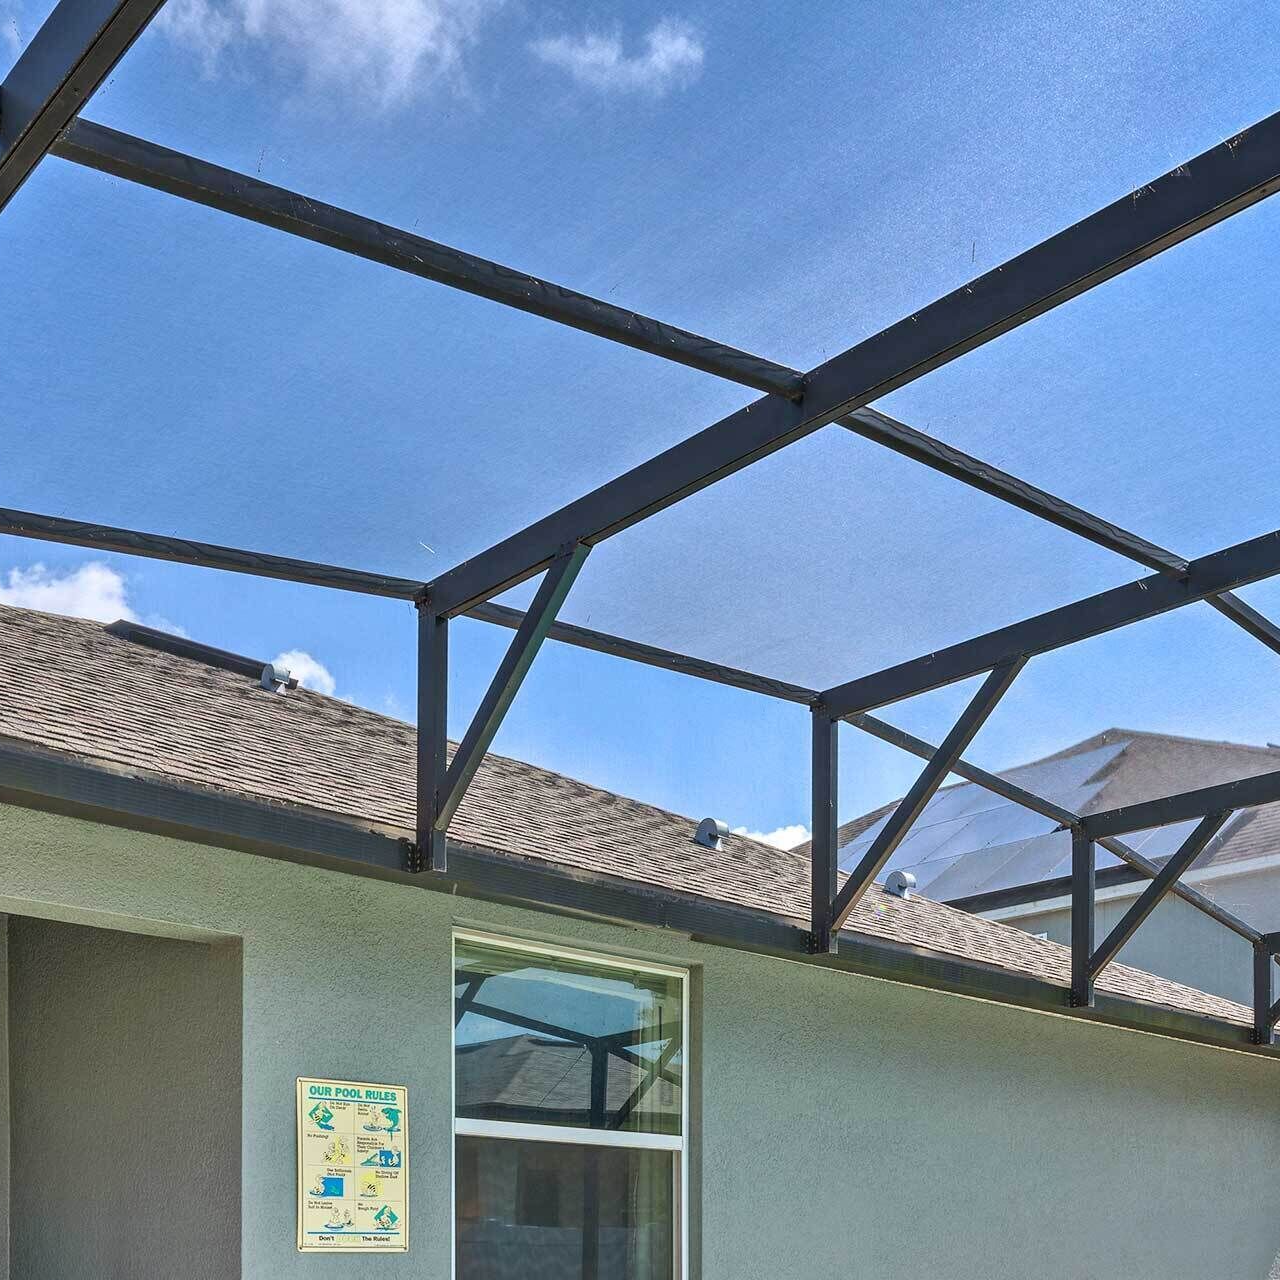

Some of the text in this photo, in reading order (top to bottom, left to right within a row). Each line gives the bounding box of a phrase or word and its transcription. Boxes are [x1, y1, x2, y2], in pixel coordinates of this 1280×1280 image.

[309, 1086, 397, 1102] OUR POOL RULES
